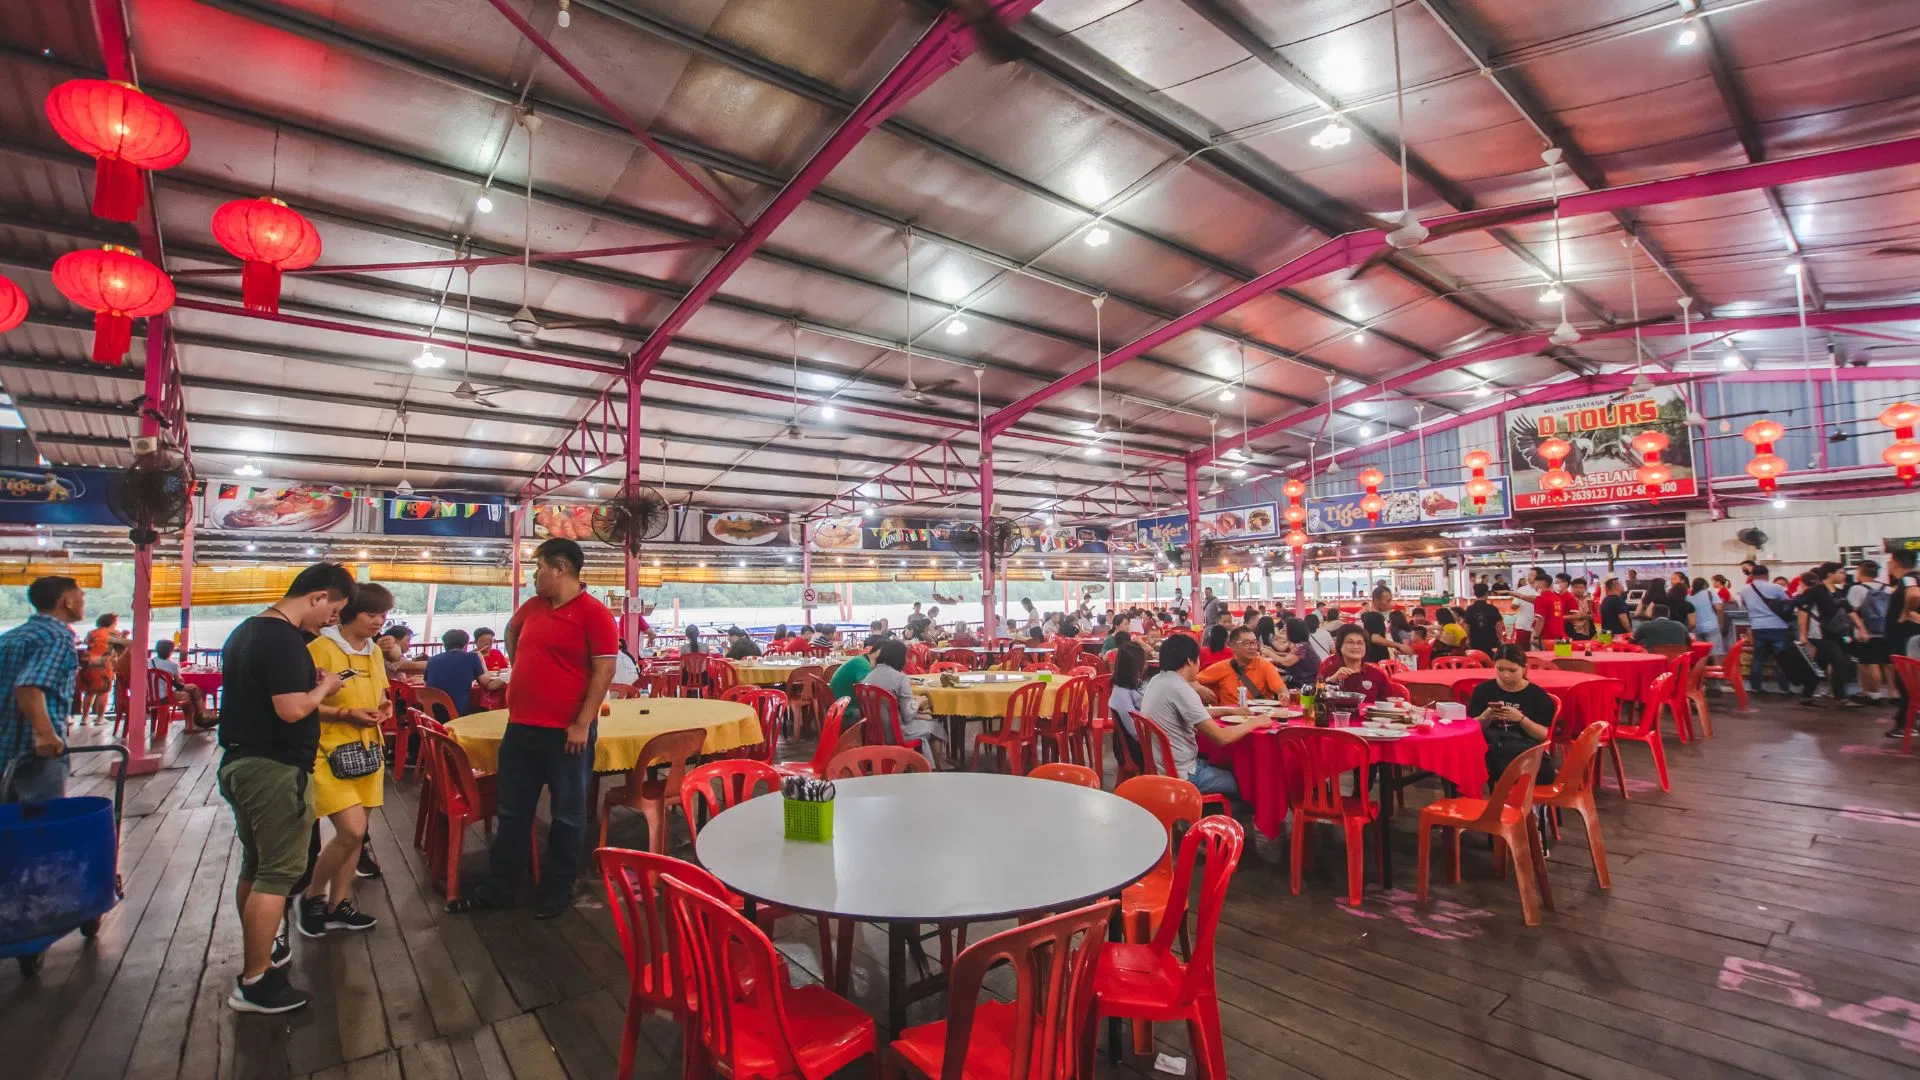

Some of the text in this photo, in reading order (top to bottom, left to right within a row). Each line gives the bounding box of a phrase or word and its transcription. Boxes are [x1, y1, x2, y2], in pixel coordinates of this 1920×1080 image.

[1537, 399, 1659, 437] D TOURS
[1150, 522, 1184, 542] Tiger
